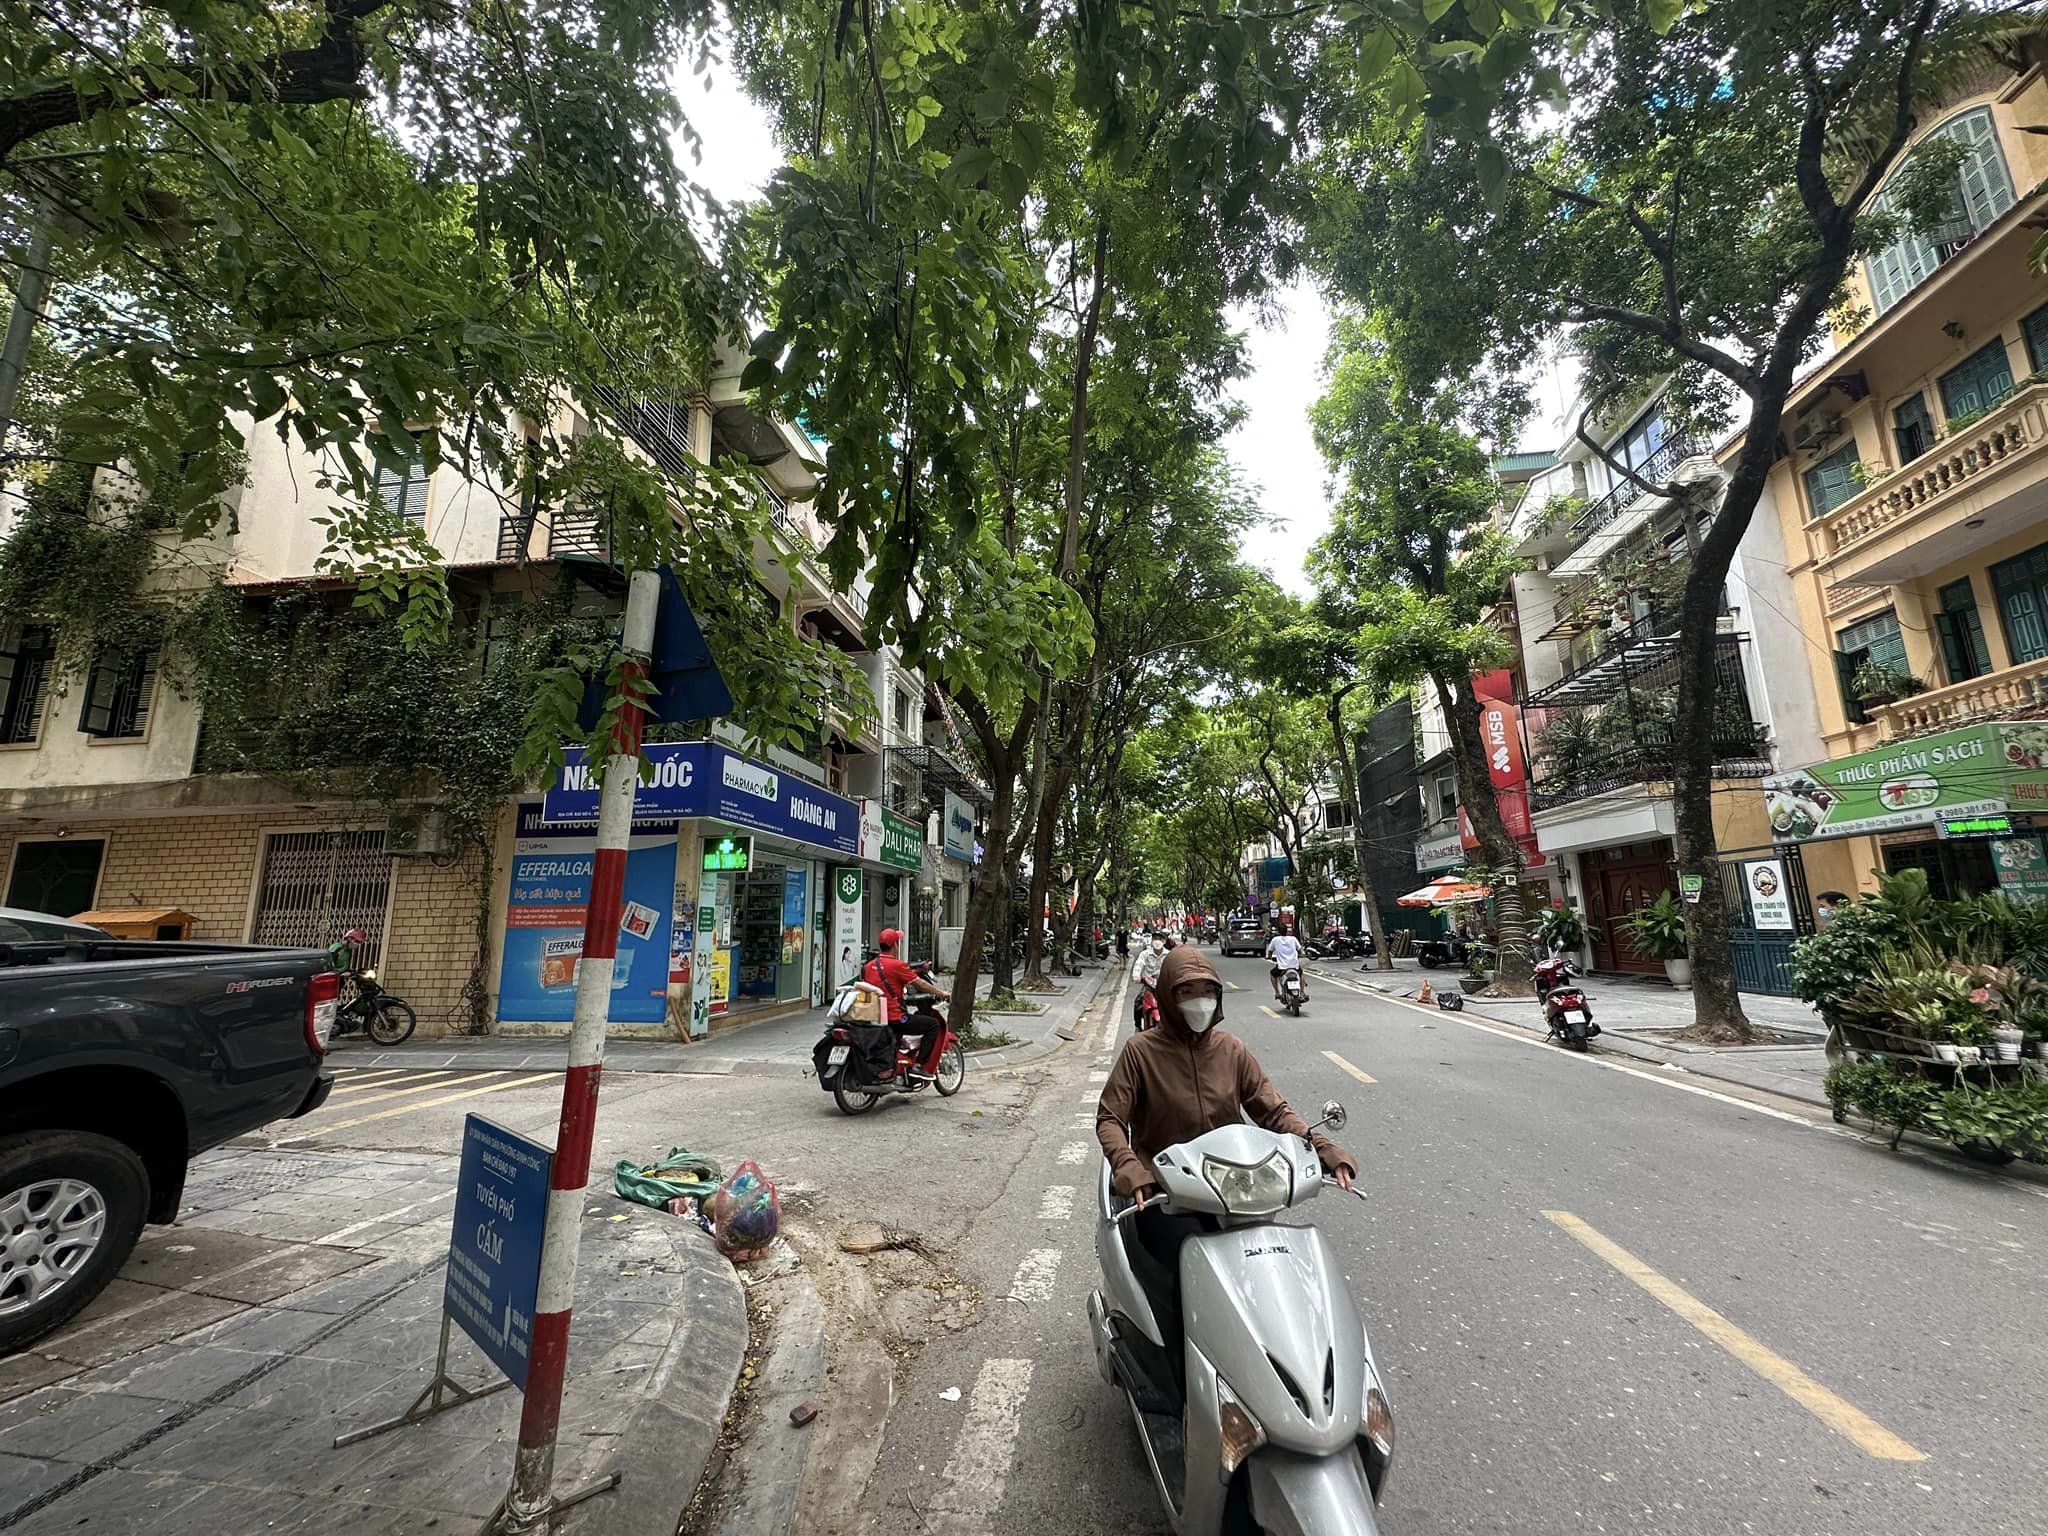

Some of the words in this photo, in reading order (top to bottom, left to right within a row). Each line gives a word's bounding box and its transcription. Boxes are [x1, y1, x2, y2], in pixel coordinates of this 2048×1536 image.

[1489, 710, 1506, 745] MSB
[1932, 738, 1985, 766] SẠCH
[724, 772, 765, 797] PHARMACY
[790, 795, 822, 827] HOÀNG
[823, 808, 837, 832] AN
[885, 829, 903, 851] DALI
[518, 862, 594, 877] EFFERALGA
[476, 1183, 498, 1212] TUYẾN
[498, 1195, 515, 1222] PHỐ
[477, 1219, 504, 1264] CẤM
